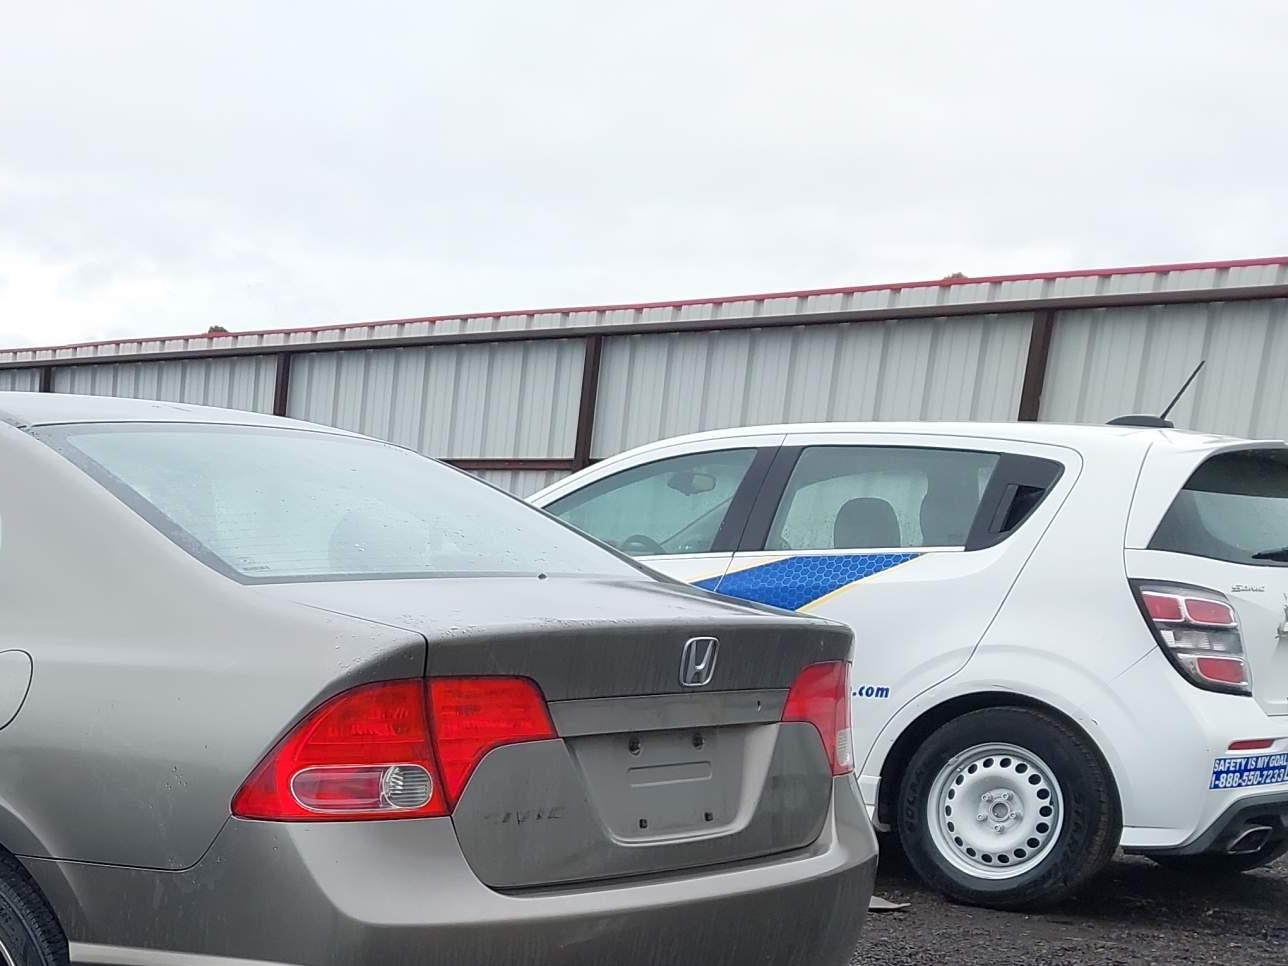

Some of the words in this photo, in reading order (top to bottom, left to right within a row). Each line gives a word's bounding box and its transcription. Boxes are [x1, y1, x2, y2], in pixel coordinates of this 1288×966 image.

[851, 686, 890, 698] .com
[1214, 759, 1247, 771] SAFETY
[1247, 757, 1256, 769] IS
[1256, 756, 1270, 768] MY
[1269, 755, 1287, 767] GOAL
[1211, 769, 1284, 788] 1-888-550-7233
